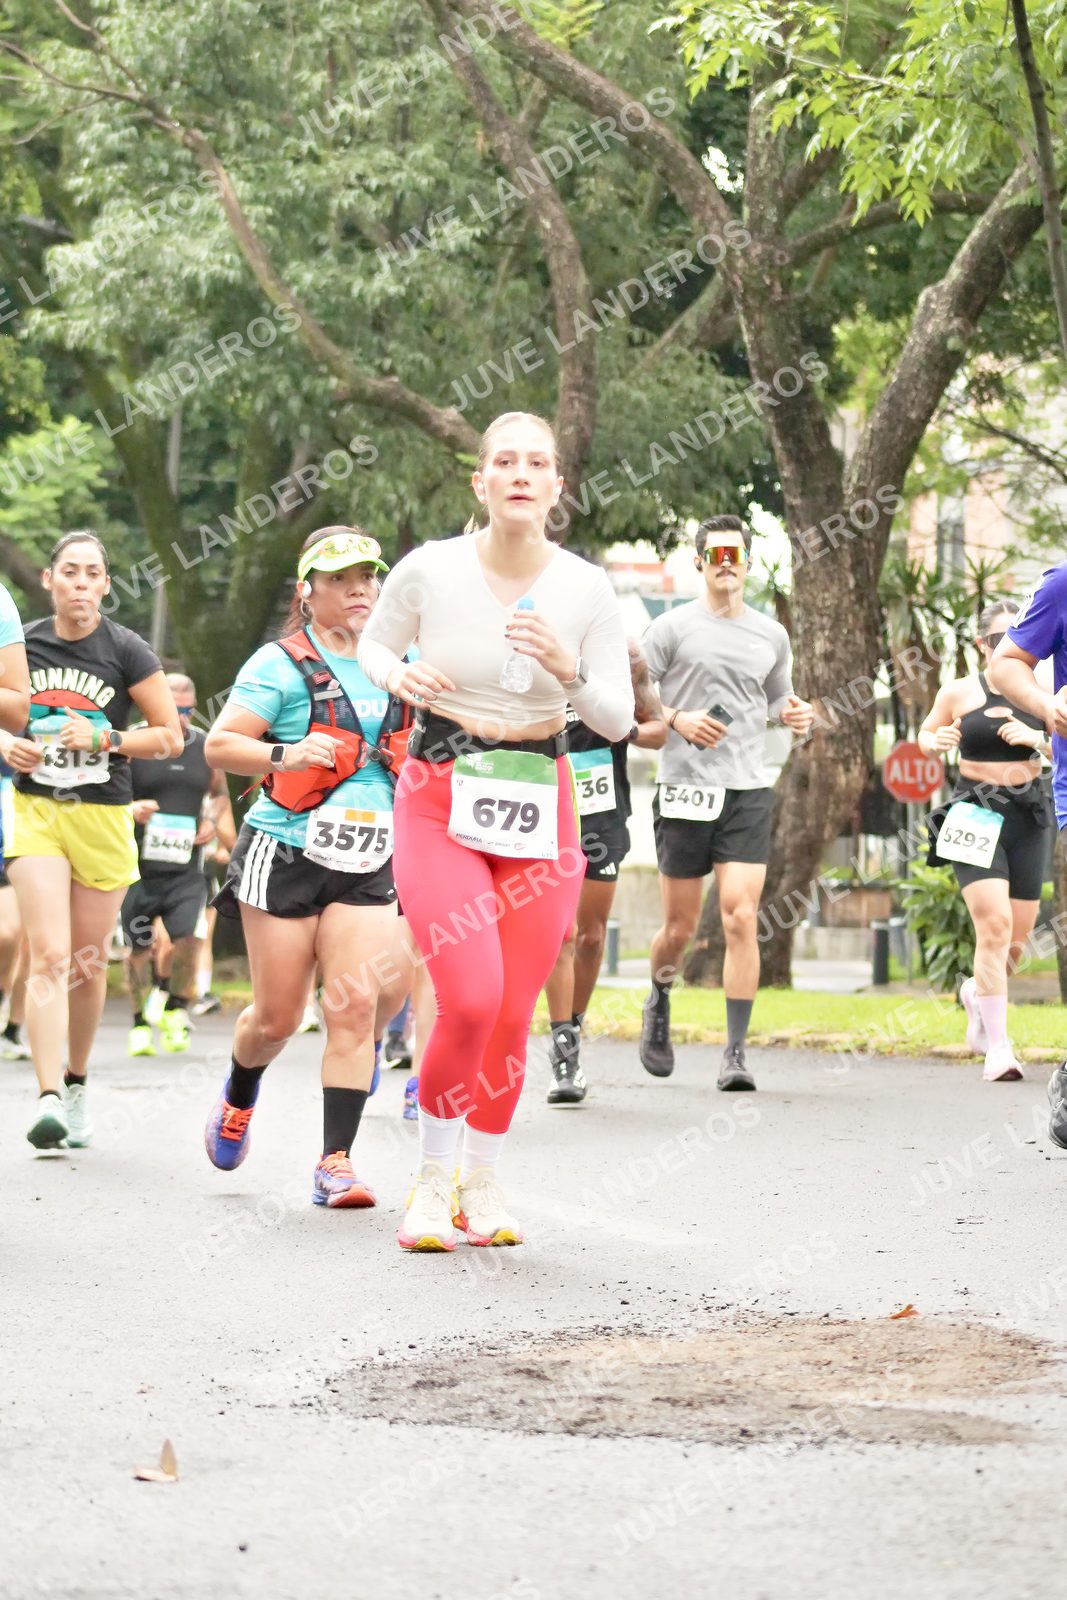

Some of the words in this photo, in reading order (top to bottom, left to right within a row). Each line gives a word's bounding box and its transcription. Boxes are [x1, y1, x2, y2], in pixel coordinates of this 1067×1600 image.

[889, 760, 940, 785] ALTO
[576, 776, 609, 799] 36
[664, 786, 715, 810] 5401
[472, 797, 541, 833] 679
[312, 820, 389, 855] 3575
[943, 827, 991, 853] 5292
